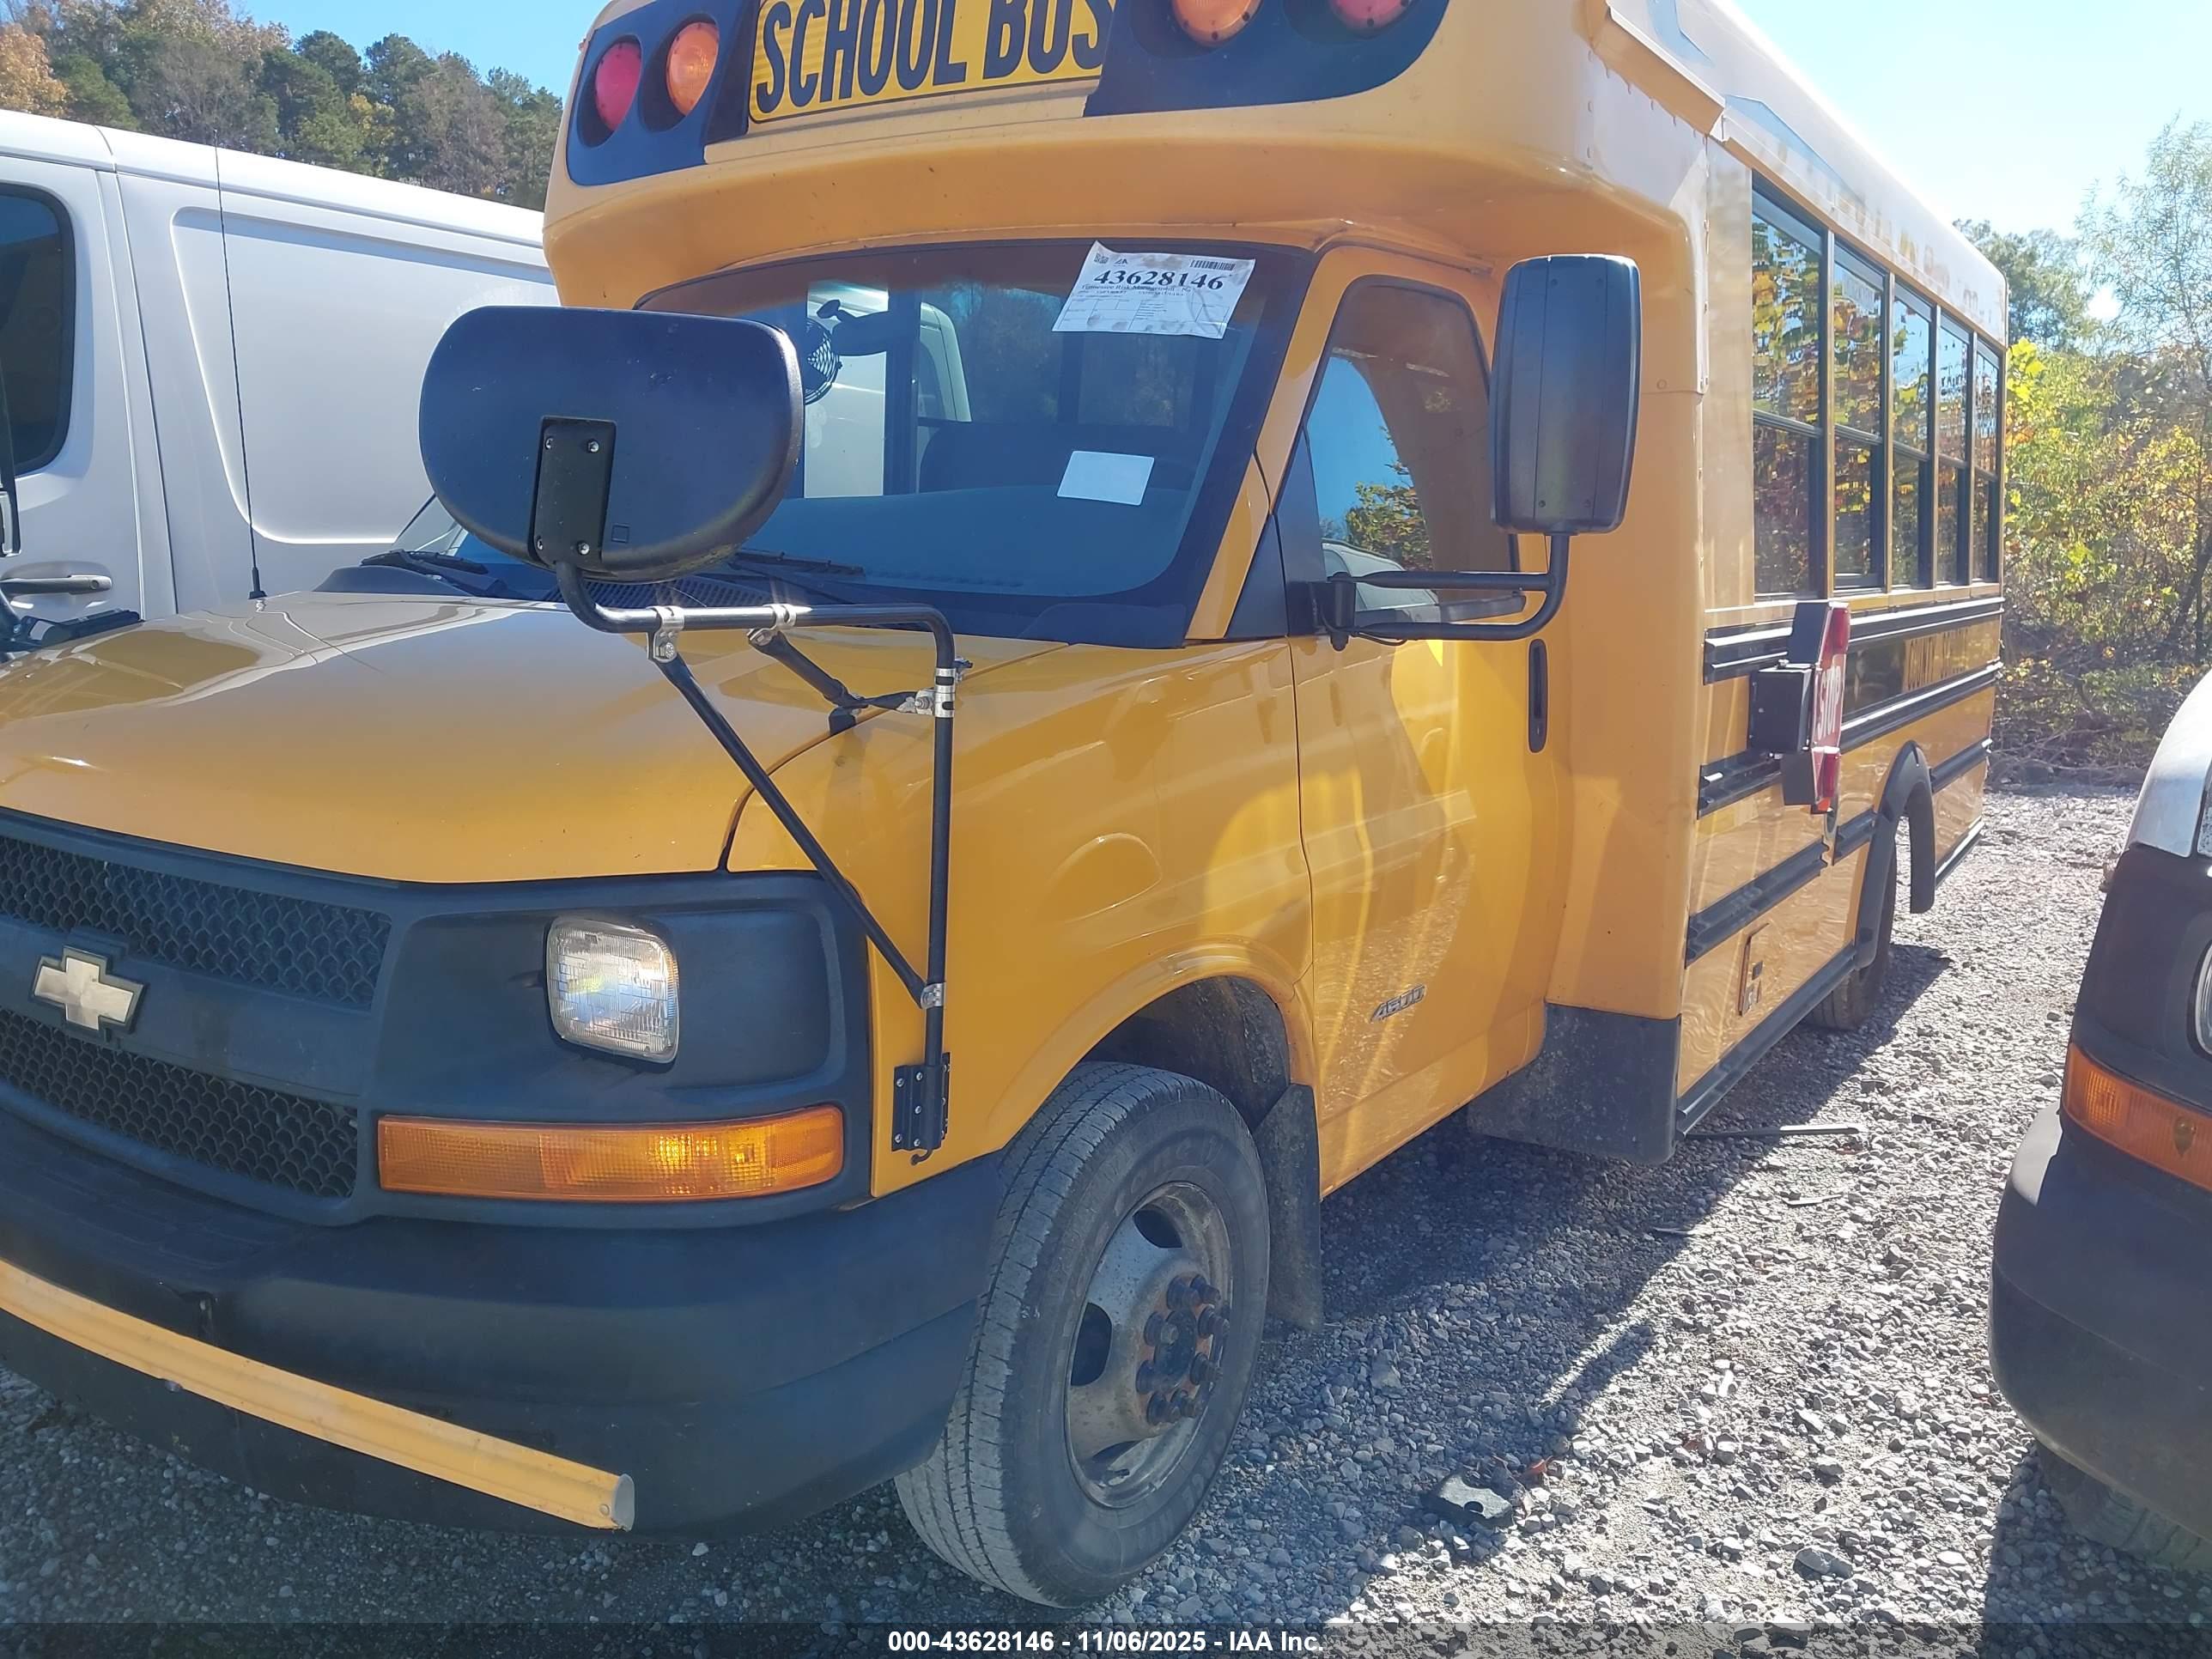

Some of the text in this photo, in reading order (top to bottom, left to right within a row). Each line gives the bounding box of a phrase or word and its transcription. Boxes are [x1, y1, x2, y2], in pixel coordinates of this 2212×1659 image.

[757, 0, 1115, 113] SCHOOL BUS
[1093, 270, 1224, 290] 43628146
[1817, 665, 1841, 741] STOP
